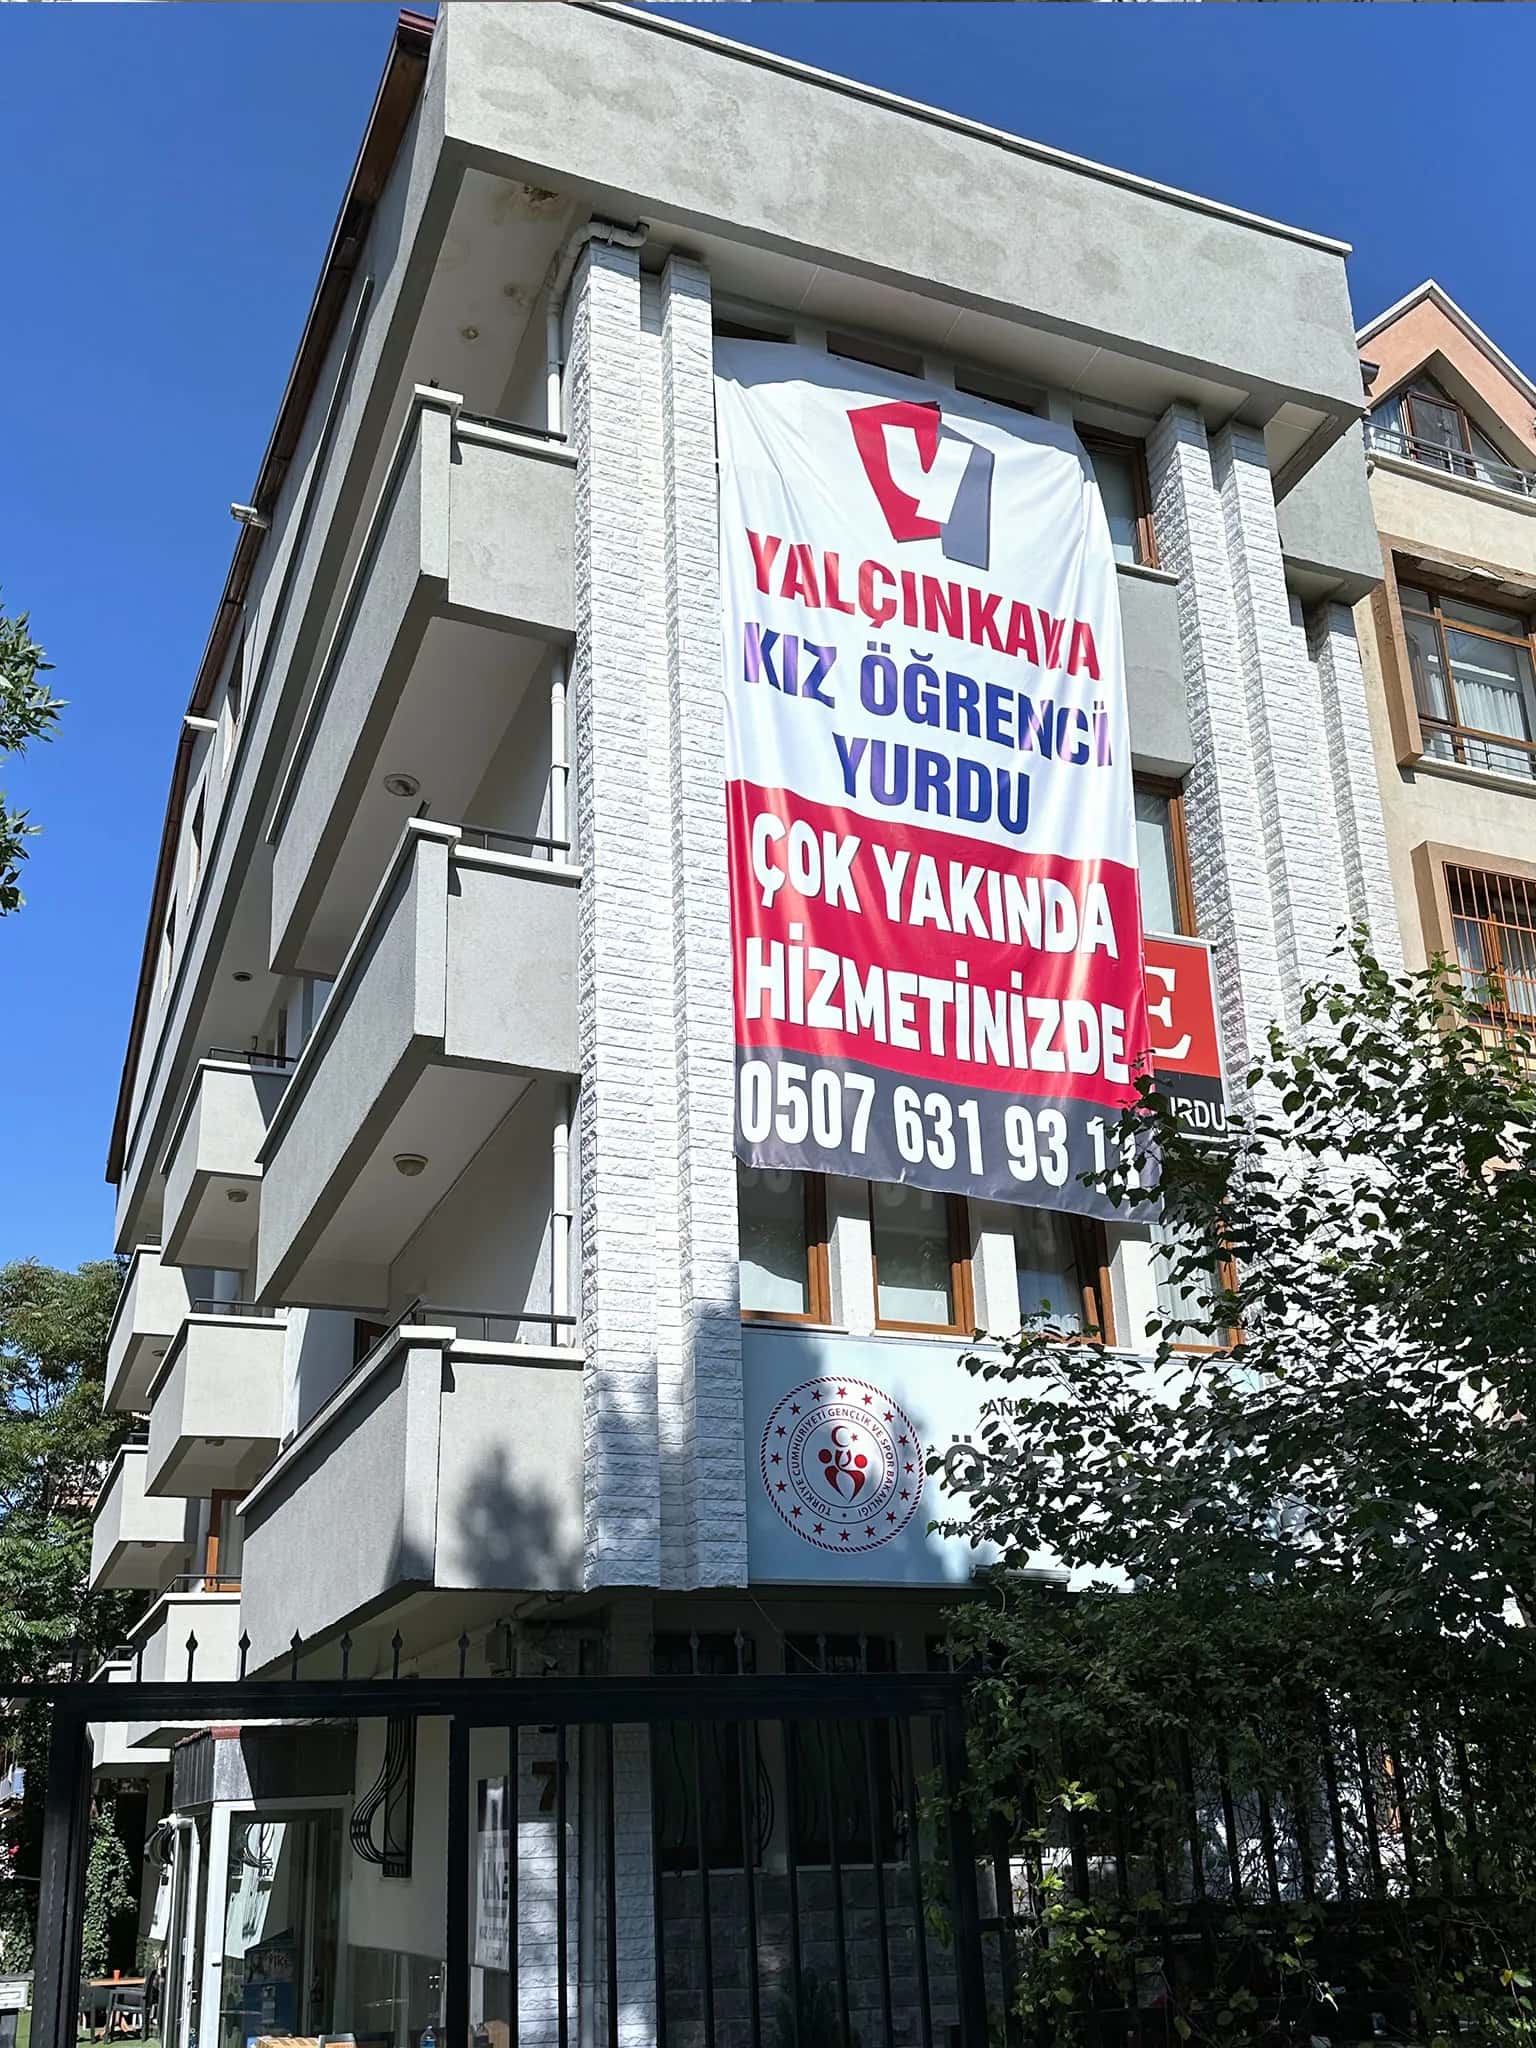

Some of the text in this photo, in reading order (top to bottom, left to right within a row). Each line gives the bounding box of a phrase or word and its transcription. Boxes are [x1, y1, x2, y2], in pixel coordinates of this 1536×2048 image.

[746, 528, 1101, 681] YALÇINKAYA
[744, 622, 1113, 768] KIZ ÖĞRENCİ
[833, 732, 1031, 835] YURDU
[752, 812, 1119, 960] ÇOK YAKINDA
[745, 923, 1130, 1084] HİZMETİNİZDE
[740, 1060, 876, 1154] 0507
[894, 1085, 984, 1176] 631
[1004, 1105, 1070, 1187] 93
[791, 1408, 895, 1518] TÜRKİYE CUMHURİYETİ GENÇLİK VE SPOR BAKANLIĞI
